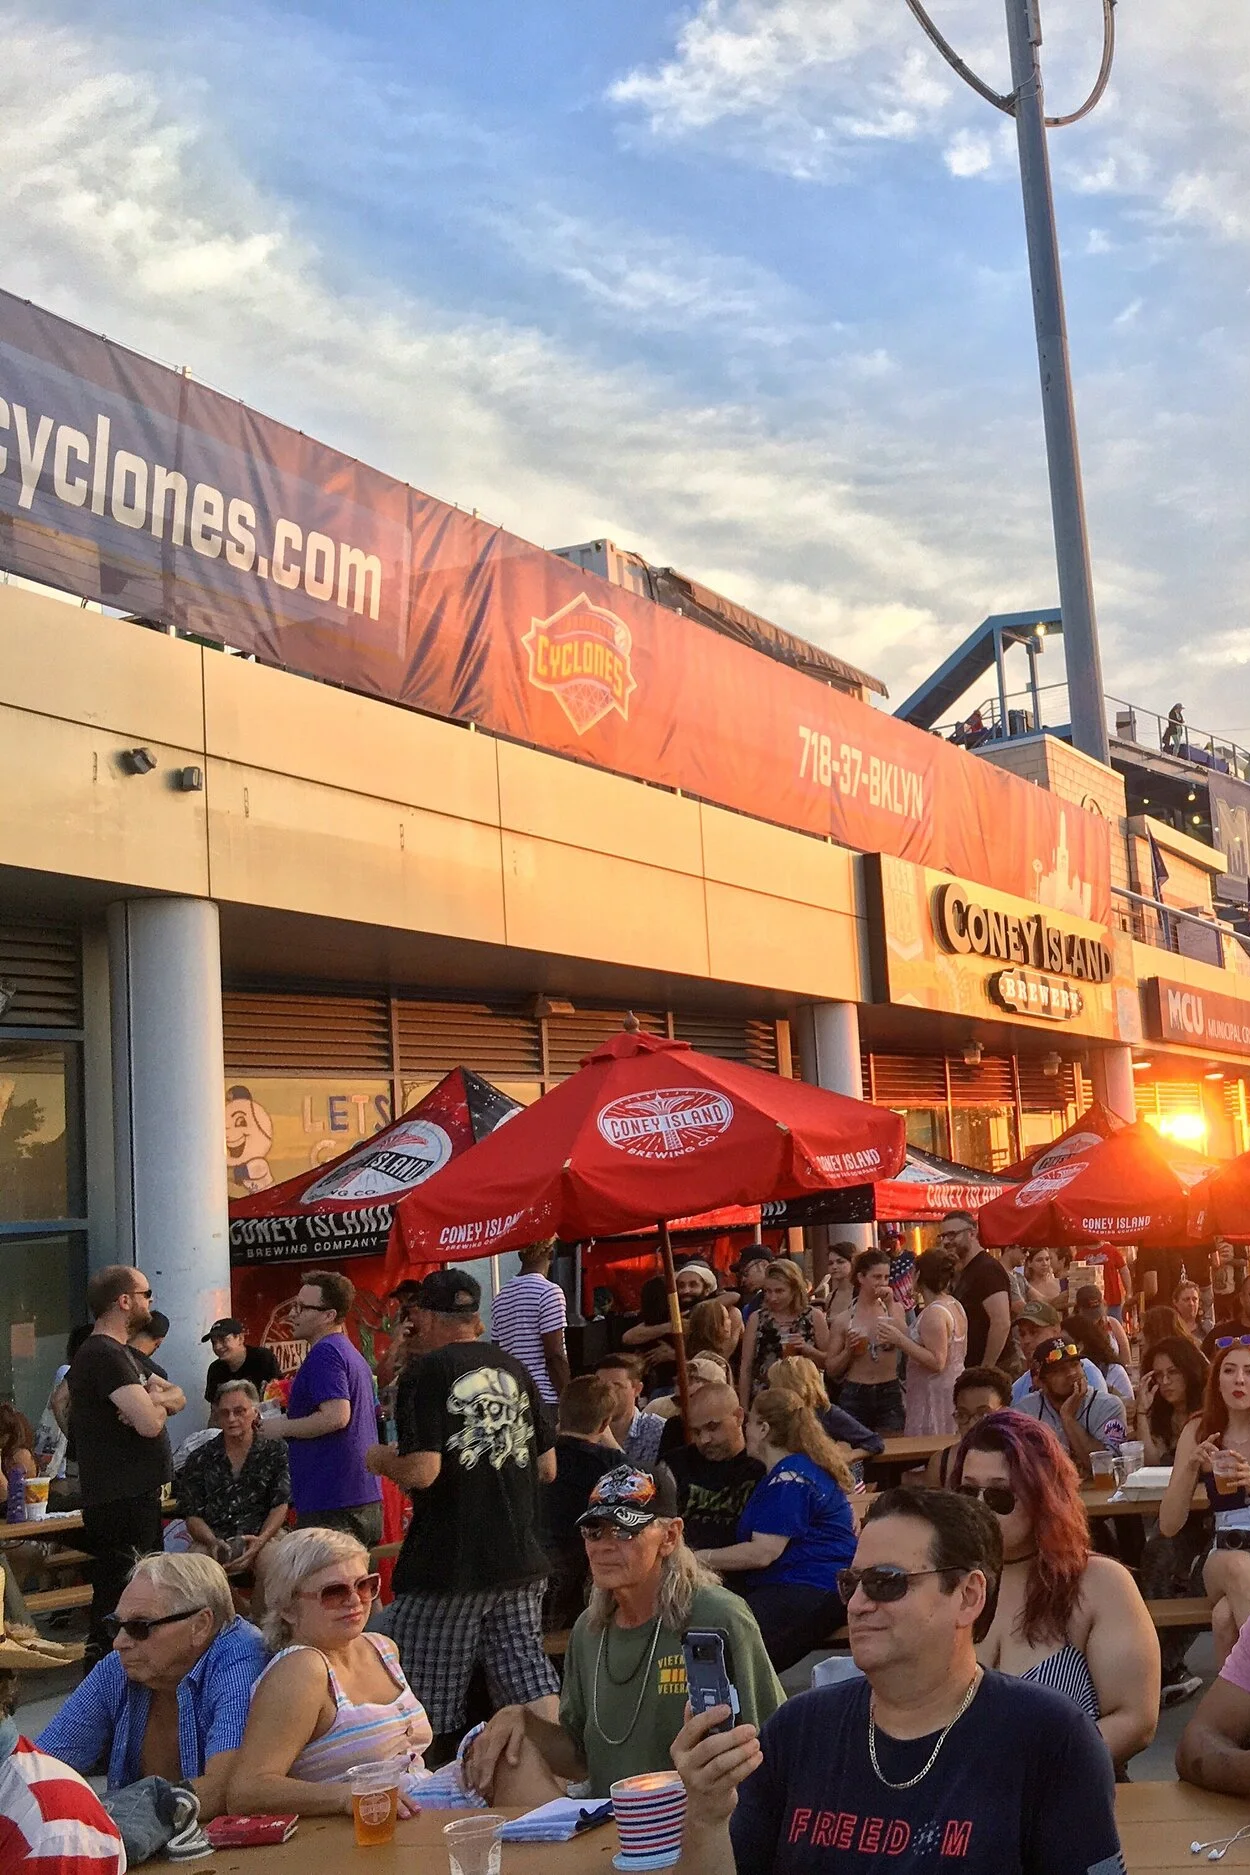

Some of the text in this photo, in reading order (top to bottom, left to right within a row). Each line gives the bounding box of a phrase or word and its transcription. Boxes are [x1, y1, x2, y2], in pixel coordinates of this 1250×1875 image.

[536, 634, 625, 699] CYCLONES
[798, 724, 924, 822] 718-37-BKLYN
[938, 882, 1037, 968] CONEY
[1040, 913, 1114, 984] ISLAND
[1004, 978, 1079, 1010] BREWERY
[1167, 988, 1205, 1036] MCU
[1207, 1017, 1243, 1044] MUNICIPAL
[304, 1095, 391, 1135] LETS
[610, 1104, 725, 1139] CONEY ISLAND
[365, 1151, 428, 1181] ISLAND
[627, 1145, 696, 1159] BREWING
[842, 1148, 881, 1171] ISLAND
[926, 1184, 964, 1209] CONEY
[230, 1203, 394, 1246] CONEY ISLAND
[440, 1221, 483, 1245] CONEY
[1082, 1215, 1151, 1230] CONEY ISLAND
[246, 1236, 378, 1258] BREWING COMPANY
